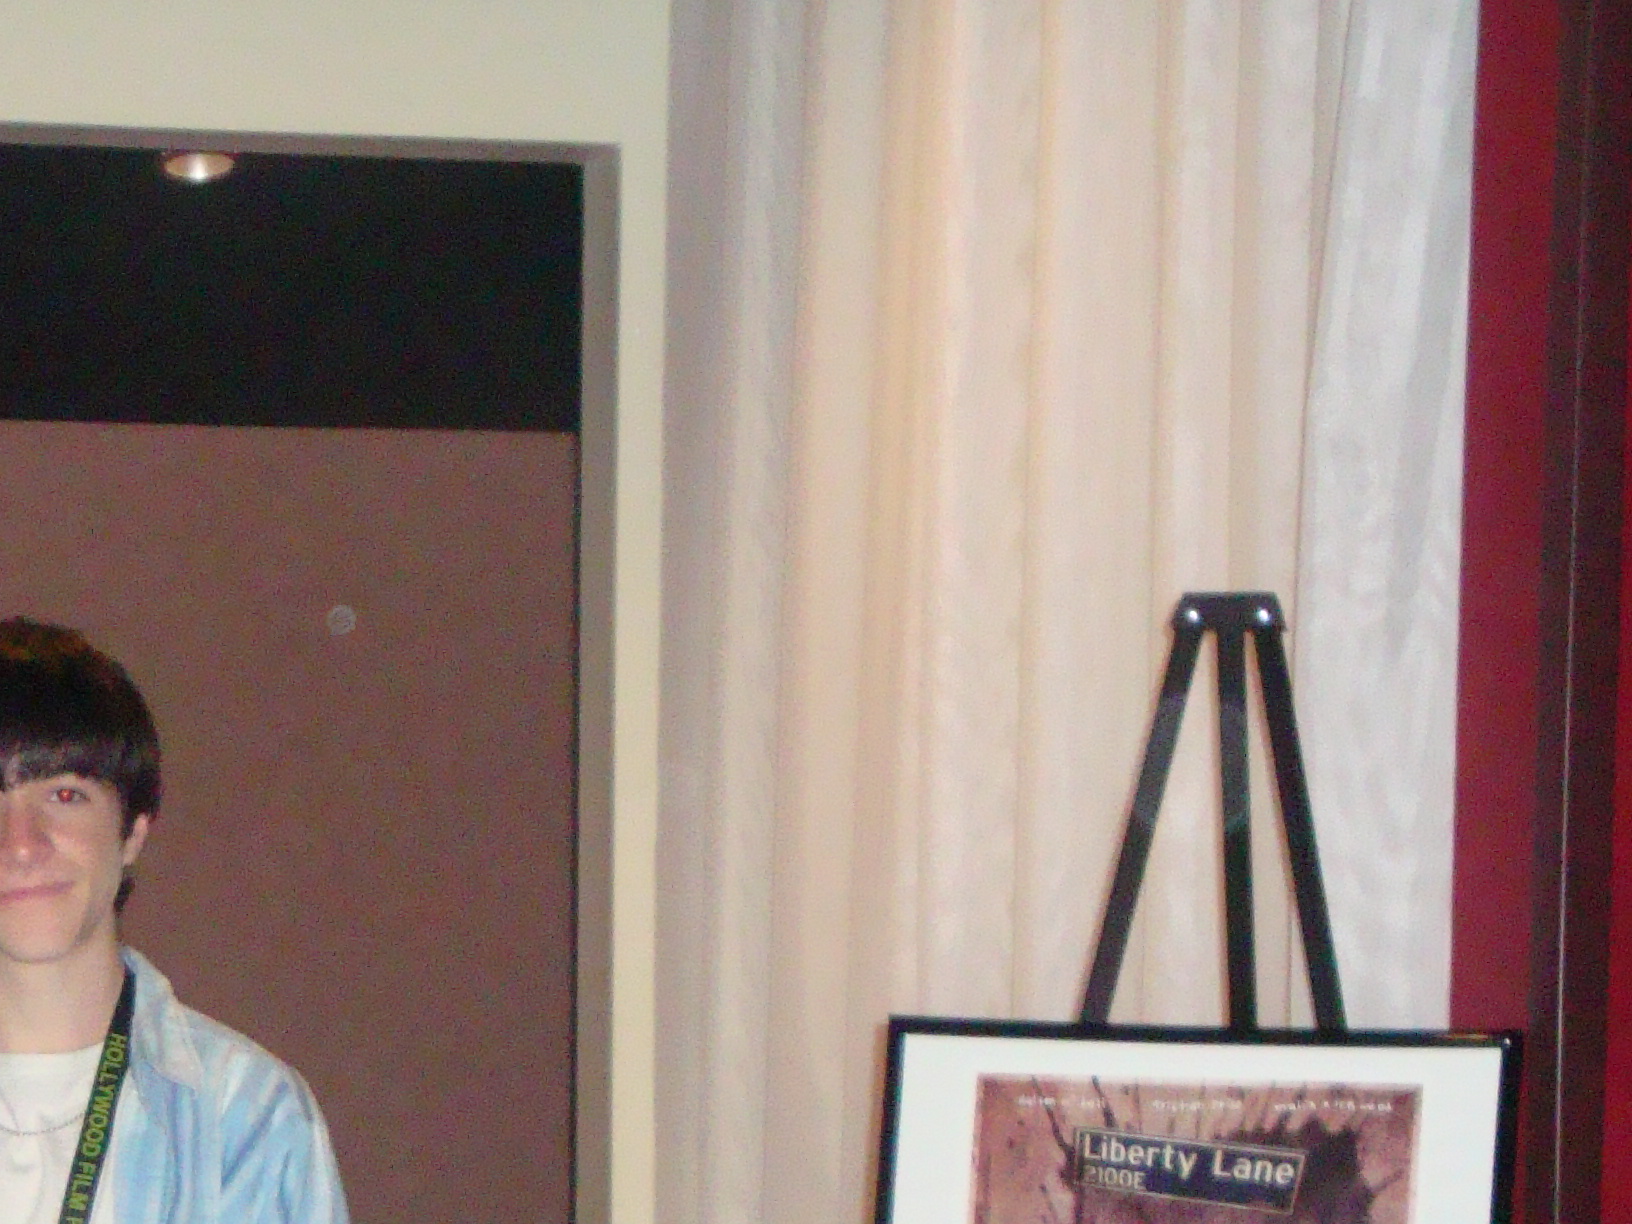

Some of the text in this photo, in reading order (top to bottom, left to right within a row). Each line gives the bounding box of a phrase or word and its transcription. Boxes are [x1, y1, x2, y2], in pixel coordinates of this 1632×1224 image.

[81, 1032, 128, 1157] HOLLYWOOD
[68, 1159, 96, 1212] FILM
[1084, 1133, 1295, 1186] Liberty Lane
[1084, 1164, 1146, 1190] 2100E
